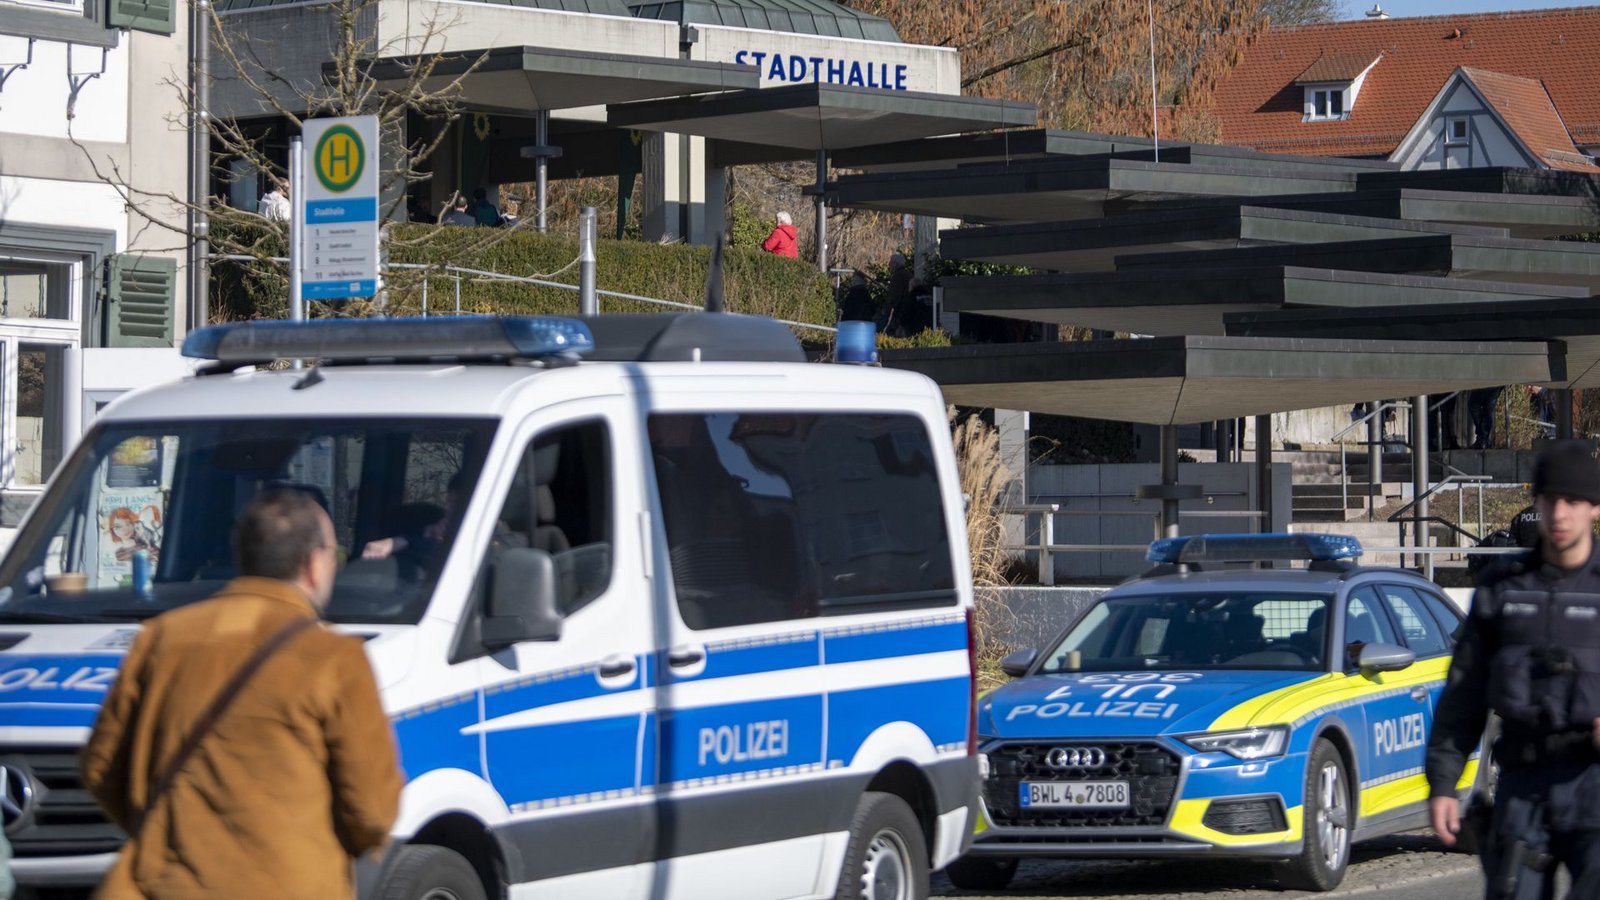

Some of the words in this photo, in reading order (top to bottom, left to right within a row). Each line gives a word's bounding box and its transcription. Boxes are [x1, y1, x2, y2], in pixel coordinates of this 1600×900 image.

[735, 50, 907, 91] STADTHALLE
[330, 139, 349, 177] H
[1005, 701, 1179, 721] POLIZEI
[698, 719, 789, 766] POLIZEI
[1374, 711, 1425, 756] POLIZEI
[1031, 785, 1060, 803] BWL
[1064, 784, 1073, 803] 4
[1085, 784, 1125, 803] 7808
